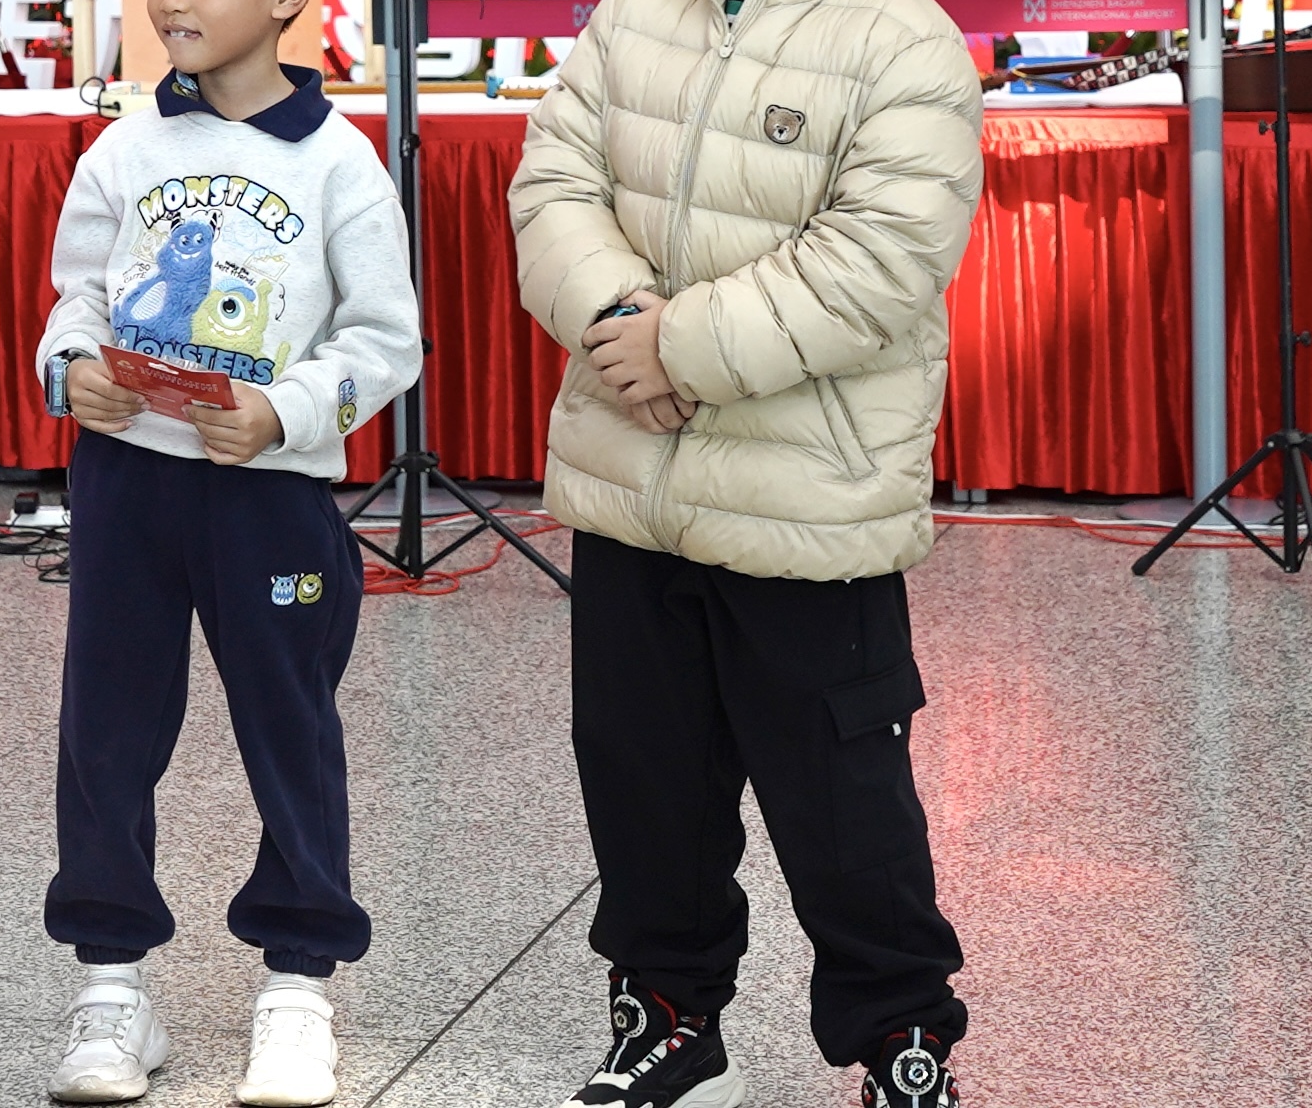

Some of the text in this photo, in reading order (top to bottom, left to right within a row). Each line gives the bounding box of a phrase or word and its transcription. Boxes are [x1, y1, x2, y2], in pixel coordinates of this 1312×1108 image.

[1051, 9, 1175, 22] INTERNATIONAL AIRPORT
[138, 174, 305, 244] MONSTERS
